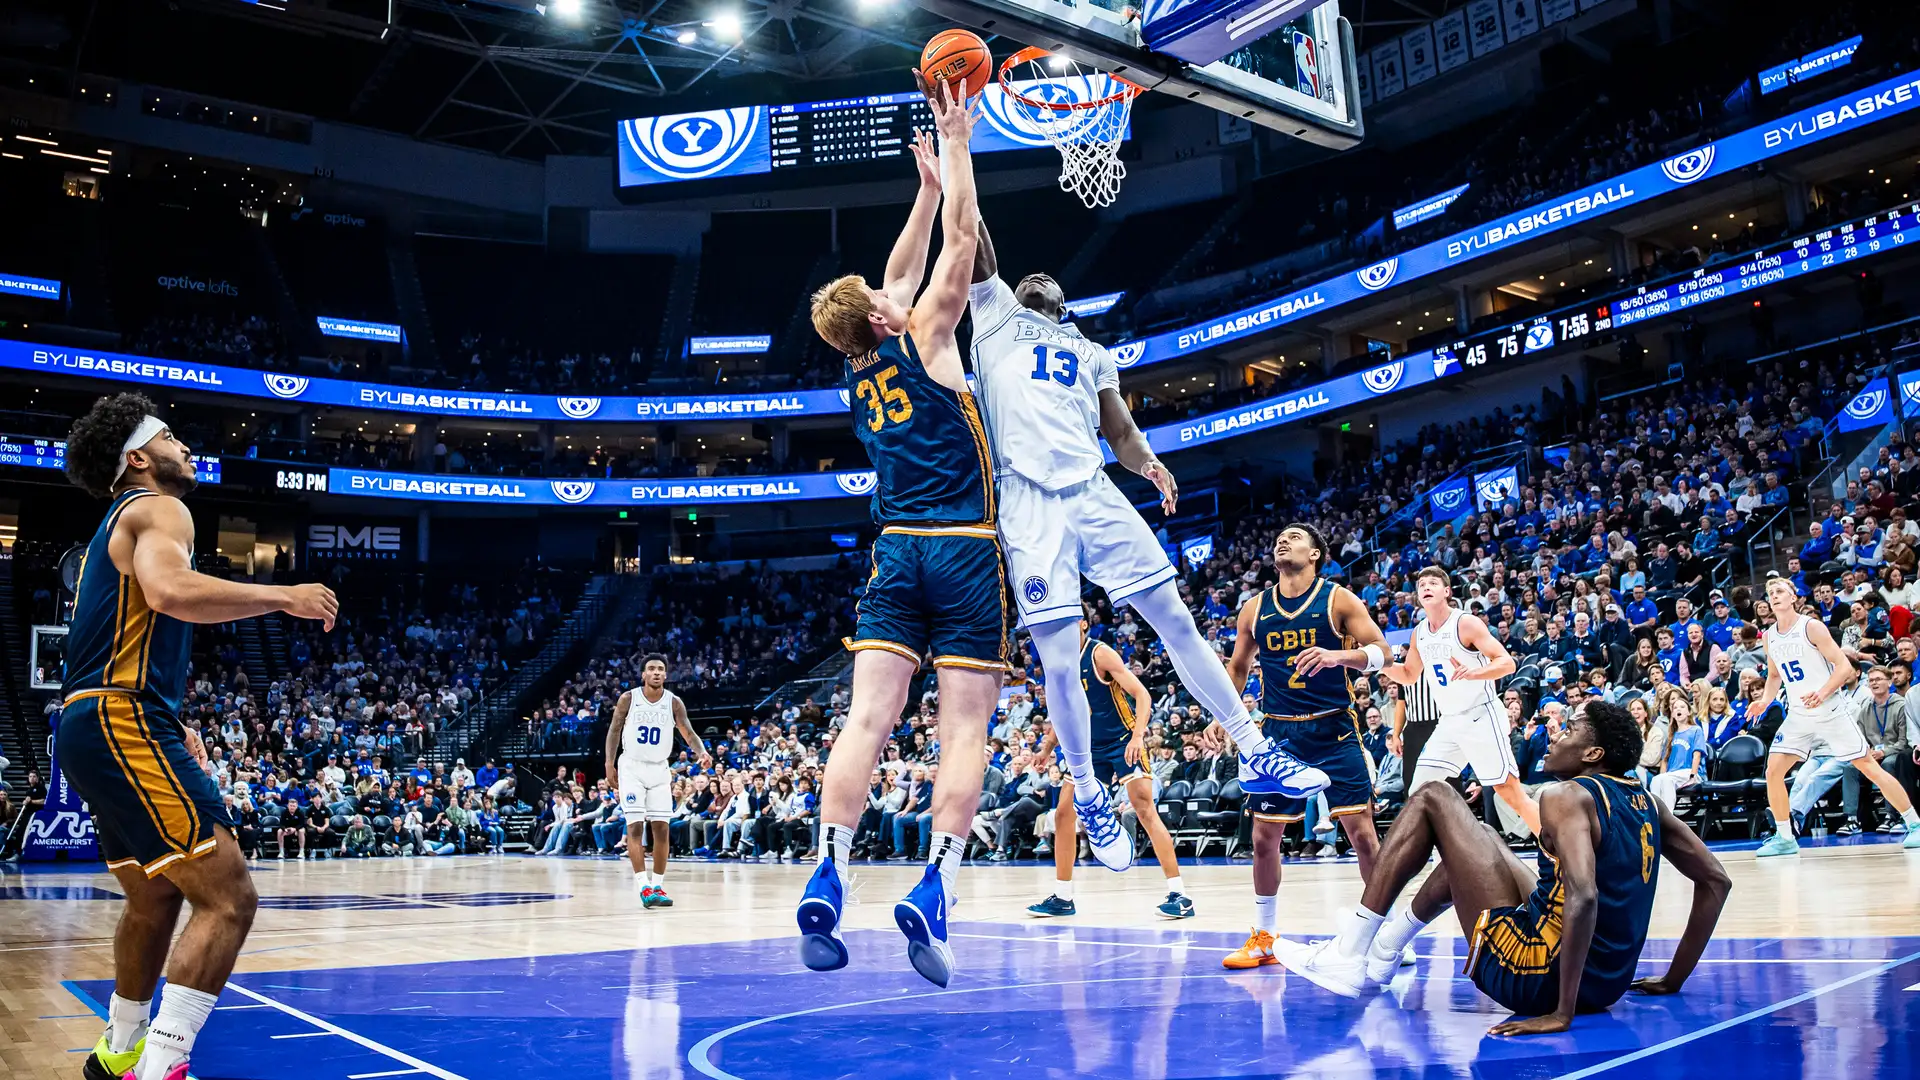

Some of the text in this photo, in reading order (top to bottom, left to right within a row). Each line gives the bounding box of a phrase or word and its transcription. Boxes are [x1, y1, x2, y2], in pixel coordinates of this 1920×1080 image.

[1475, 16, 1496, 37] 32
[1443, 32, 1459, 52] 12
[1414, 48, 1425, 65] 9
[1380, 61, 1395, 81] 14
[323, 213, 366, 228] aptive
[1448, 183, 1634, 258] BYUBASKETBALL
[1755, 251, 1763, 260] FT
[1841, 224, 1854, 235] REB
[1864, 217, 1876, 228] AST
[1888, 210, 1901, 221] STL
[1620, 296, 1643, 311] 18/50
[1679, 279, 1698, 294] 5/19
[1740, 263, 1756, 276] 3/4
[1757, 255, 1782, 271] (75%)
[1797, 247, 1808, 259] 10
[1820, 240, 1831, 252] 15
[1842, 233, 1855, 246] 25
[1868, 227, 1876, 238] 8
[1892, 220, 1900, 230] 4
[157, 274, 240, 297] aptive lofts
[1620, 232, 1904, 324] 29/49 (59%) 9/18 (50%) 3/5 (60%) 6 22 28 19 10
[1178, 290, 1326, 349] BYUBASKETBALL
[1596, 306, 1609, 319] 14
[1559, 313, 1589, 341] 7:55
[1595, 318, 1612, 331] 2ND
[1466, 344, 1487, 367] 45
[1497, 335, 1518, 358] 75
[33, 350, 222, 386] BYUBASKETBALL
[1031, 345, 1079, 387] 13
[360, 389, 533, 413] BYUBASKETBALL
[637, 397, 804, 415] BYUBASKETBALL
[856, 365, 914, 433] 35
[1180, 391, 1330, 442] BYUBASKETBALL
[0, 445, 64, 457] (75%) 10 15
[36, 457, 42, 465] 6
[205, 473, 214, 481] 14
[207, 463, 213, 472] 5
[276, 470, 327, 492] 8:33 PM
[351, 475, 526, 498] BYUBASKETBALL
[631, 481, 800, 499] BYUBASKETBALL
[308, 524, 401, 550] SME
[310, 551, 398, 559] INDUSTRIES
[1266, 628, 1317, 651] CBU
[1286, 656, 1307, 689] 2
[1433, 664, 1448, 687] 5
[1781, 660, 1805, 682] 15
[633, 711, 669, 724] BYU
[637, 726, 661, 745] 30
[33, 838, 93, 846] AMERICA FIRST
[1640, 822, 1655, 884] 6
